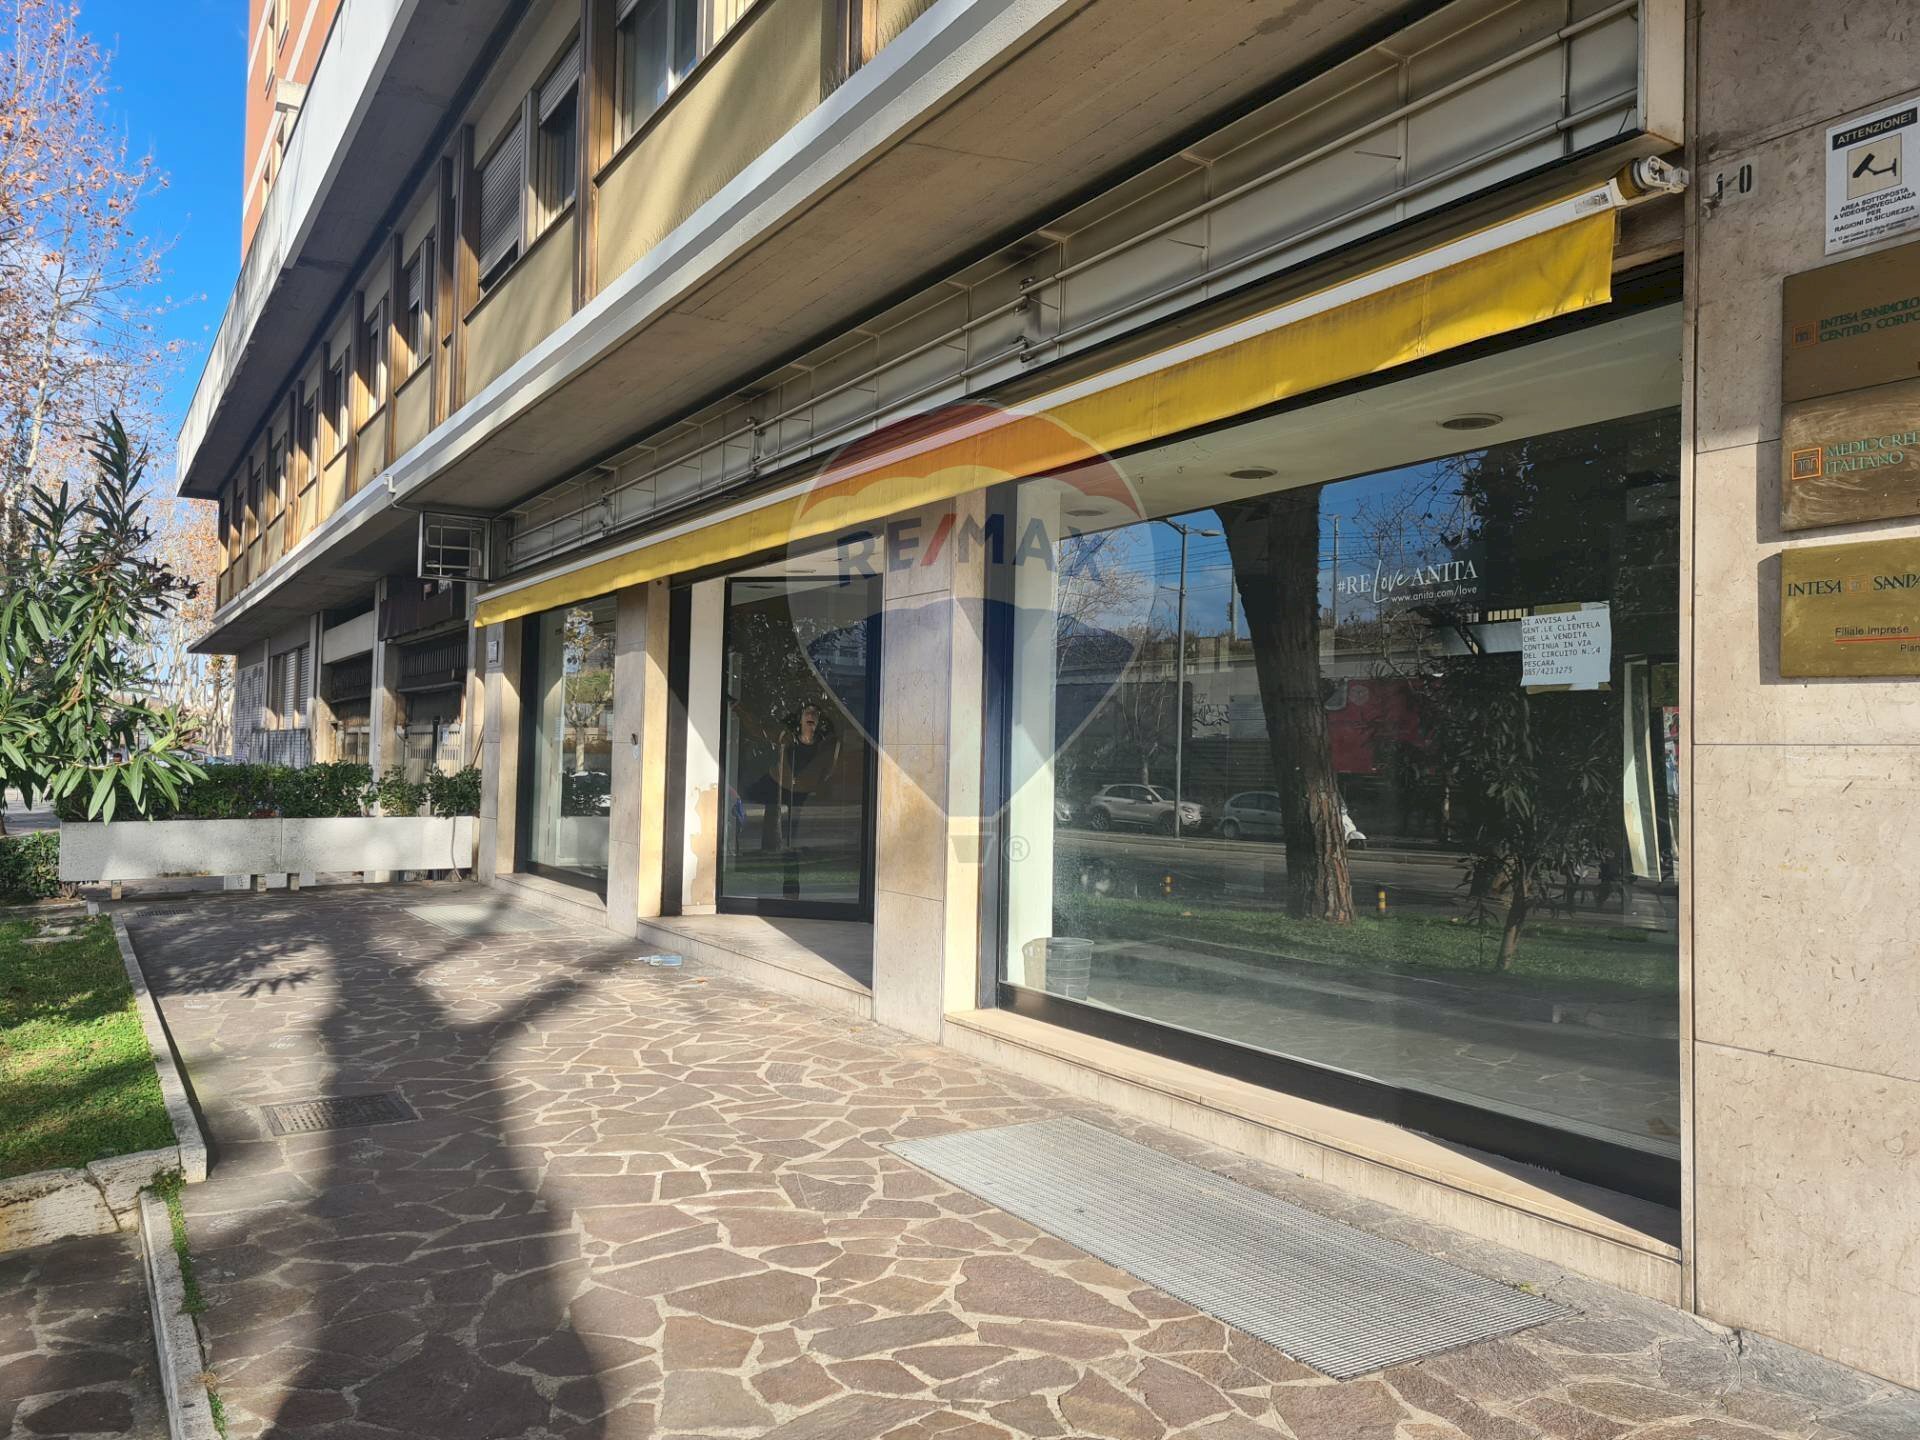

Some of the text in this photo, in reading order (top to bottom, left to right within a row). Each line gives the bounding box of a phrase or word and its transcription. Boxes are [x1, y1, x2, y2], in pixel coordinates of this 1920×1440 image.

[1837, 112, 1913, 145] ATTENZIONE!
[1840, 192, 1917, 219] VIDEOSORVEGLIANZA
[1841, 187, 1909, 213] AREA SOTTOPOSTA
[1835, 219, 1864, 233] RAGIONI
[1874, 205, 1915, 221] SICUREZZA
[1867, 208, 1882, 217] PER
[1820, 312, 1859, 330] INTESA
[1819, 322, 1871, 342] CENTRO
[1825, 451, 1904, 475] ITALIANO
[1409, 560, 1479, 587] ANITA
[1391, 586, 1478, 603] www.anita.com/love
[1787, 579, 1842, 597] INTESA
[1522, 614, 1577, 626] SI AVVISA LA
[1558, 621, 1601, 632] CLIENTELA
[1523, 635, 1537, 643] CHE
[1553, 631, 1588, 641] VENDITA
[1834, 627, 1865, 636] Filiale
[1523, 642, 1559, 651] CONTINUA
[1577, 639, 1592, 647] VIA
[1541, 649, 1577, 658] CIRCUITO
[1524, 660, 1555, 668] PESCARA
